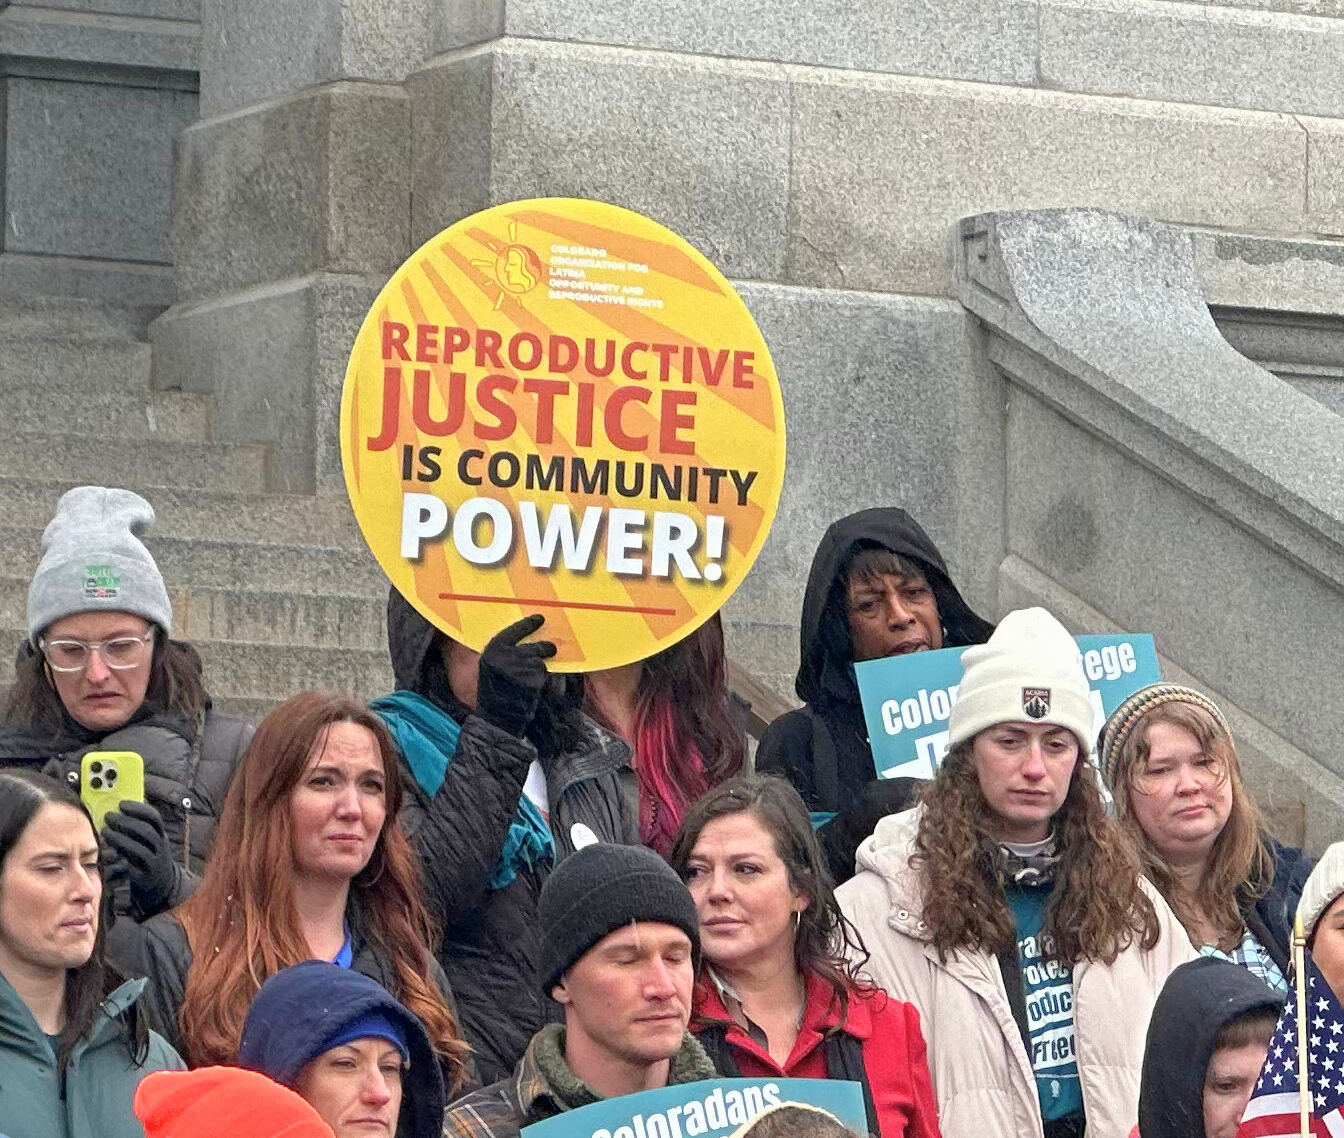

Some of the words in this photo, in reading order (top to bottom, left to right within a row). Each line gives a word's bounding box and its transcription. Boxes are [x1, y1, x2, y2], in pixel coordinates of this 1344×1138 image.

[381, 321, 755, 389] REPRODUCTIVE
[367, 367, 698, 456] JUSTICE
[401, 444, 442, 482] IS
[456, 450, 759, 506] COMMUNITY
[400, 492, 726, 582] POWER!
